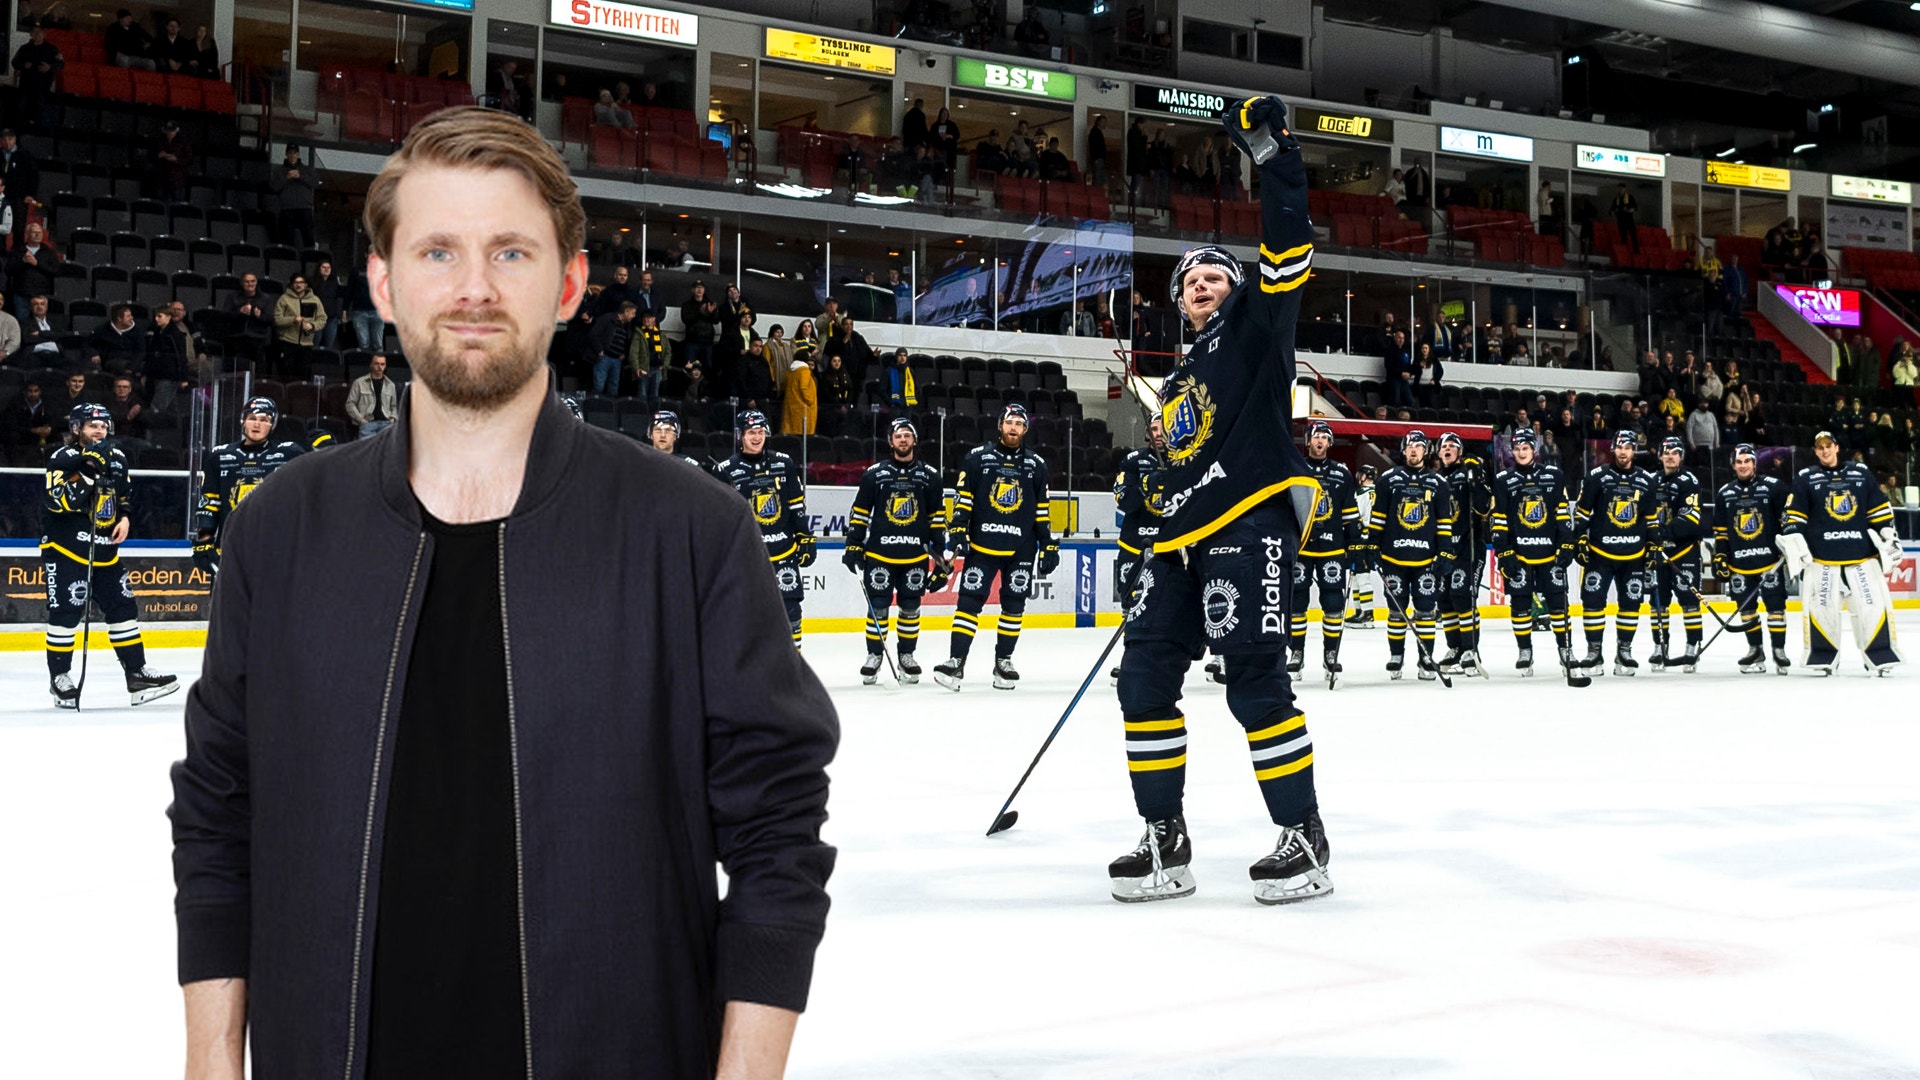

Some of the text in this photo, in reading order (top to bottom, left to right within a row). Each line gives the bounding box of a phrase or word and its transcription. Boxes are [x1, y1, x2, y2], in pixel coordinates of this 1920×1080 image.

[571, 0, 680, 36] STYRHYTTEN
[820, 38, 871, 53] TYSSLINGE
[985, 64, 1049, 92] BST
[1158, 88, 1224, 111] MÅNSBRO
[1169, 106, 1212, 118] FASTIGHETER
[1794, 289, 1842, 311] GRW
[46, 469, 64, 489] 12
[981, 523, 1022, 536] SCANIA
[1823, 530, 1863, 540] SCANIA
[880, 535, 921, 545] SCANIA
[1393, 539, 1430, 549] SCANIA
[1516, 536, 1553, 545] SCANIA
[1602, 535, 1641, 544] SCANIA
[1209, 547, 1242, 555] CCM
[1734, 547, 1771, 558] SCANIA
[8, 567, 47, 585] Rub
[802, 575, 826, 590] EN
[45, 562, 60, 608] Dialect
[1081, 555, 1092, 613] CCM
[1261, 537, 1285, 634] Dialect
[145, 602, 198, 613] rubsol.se
